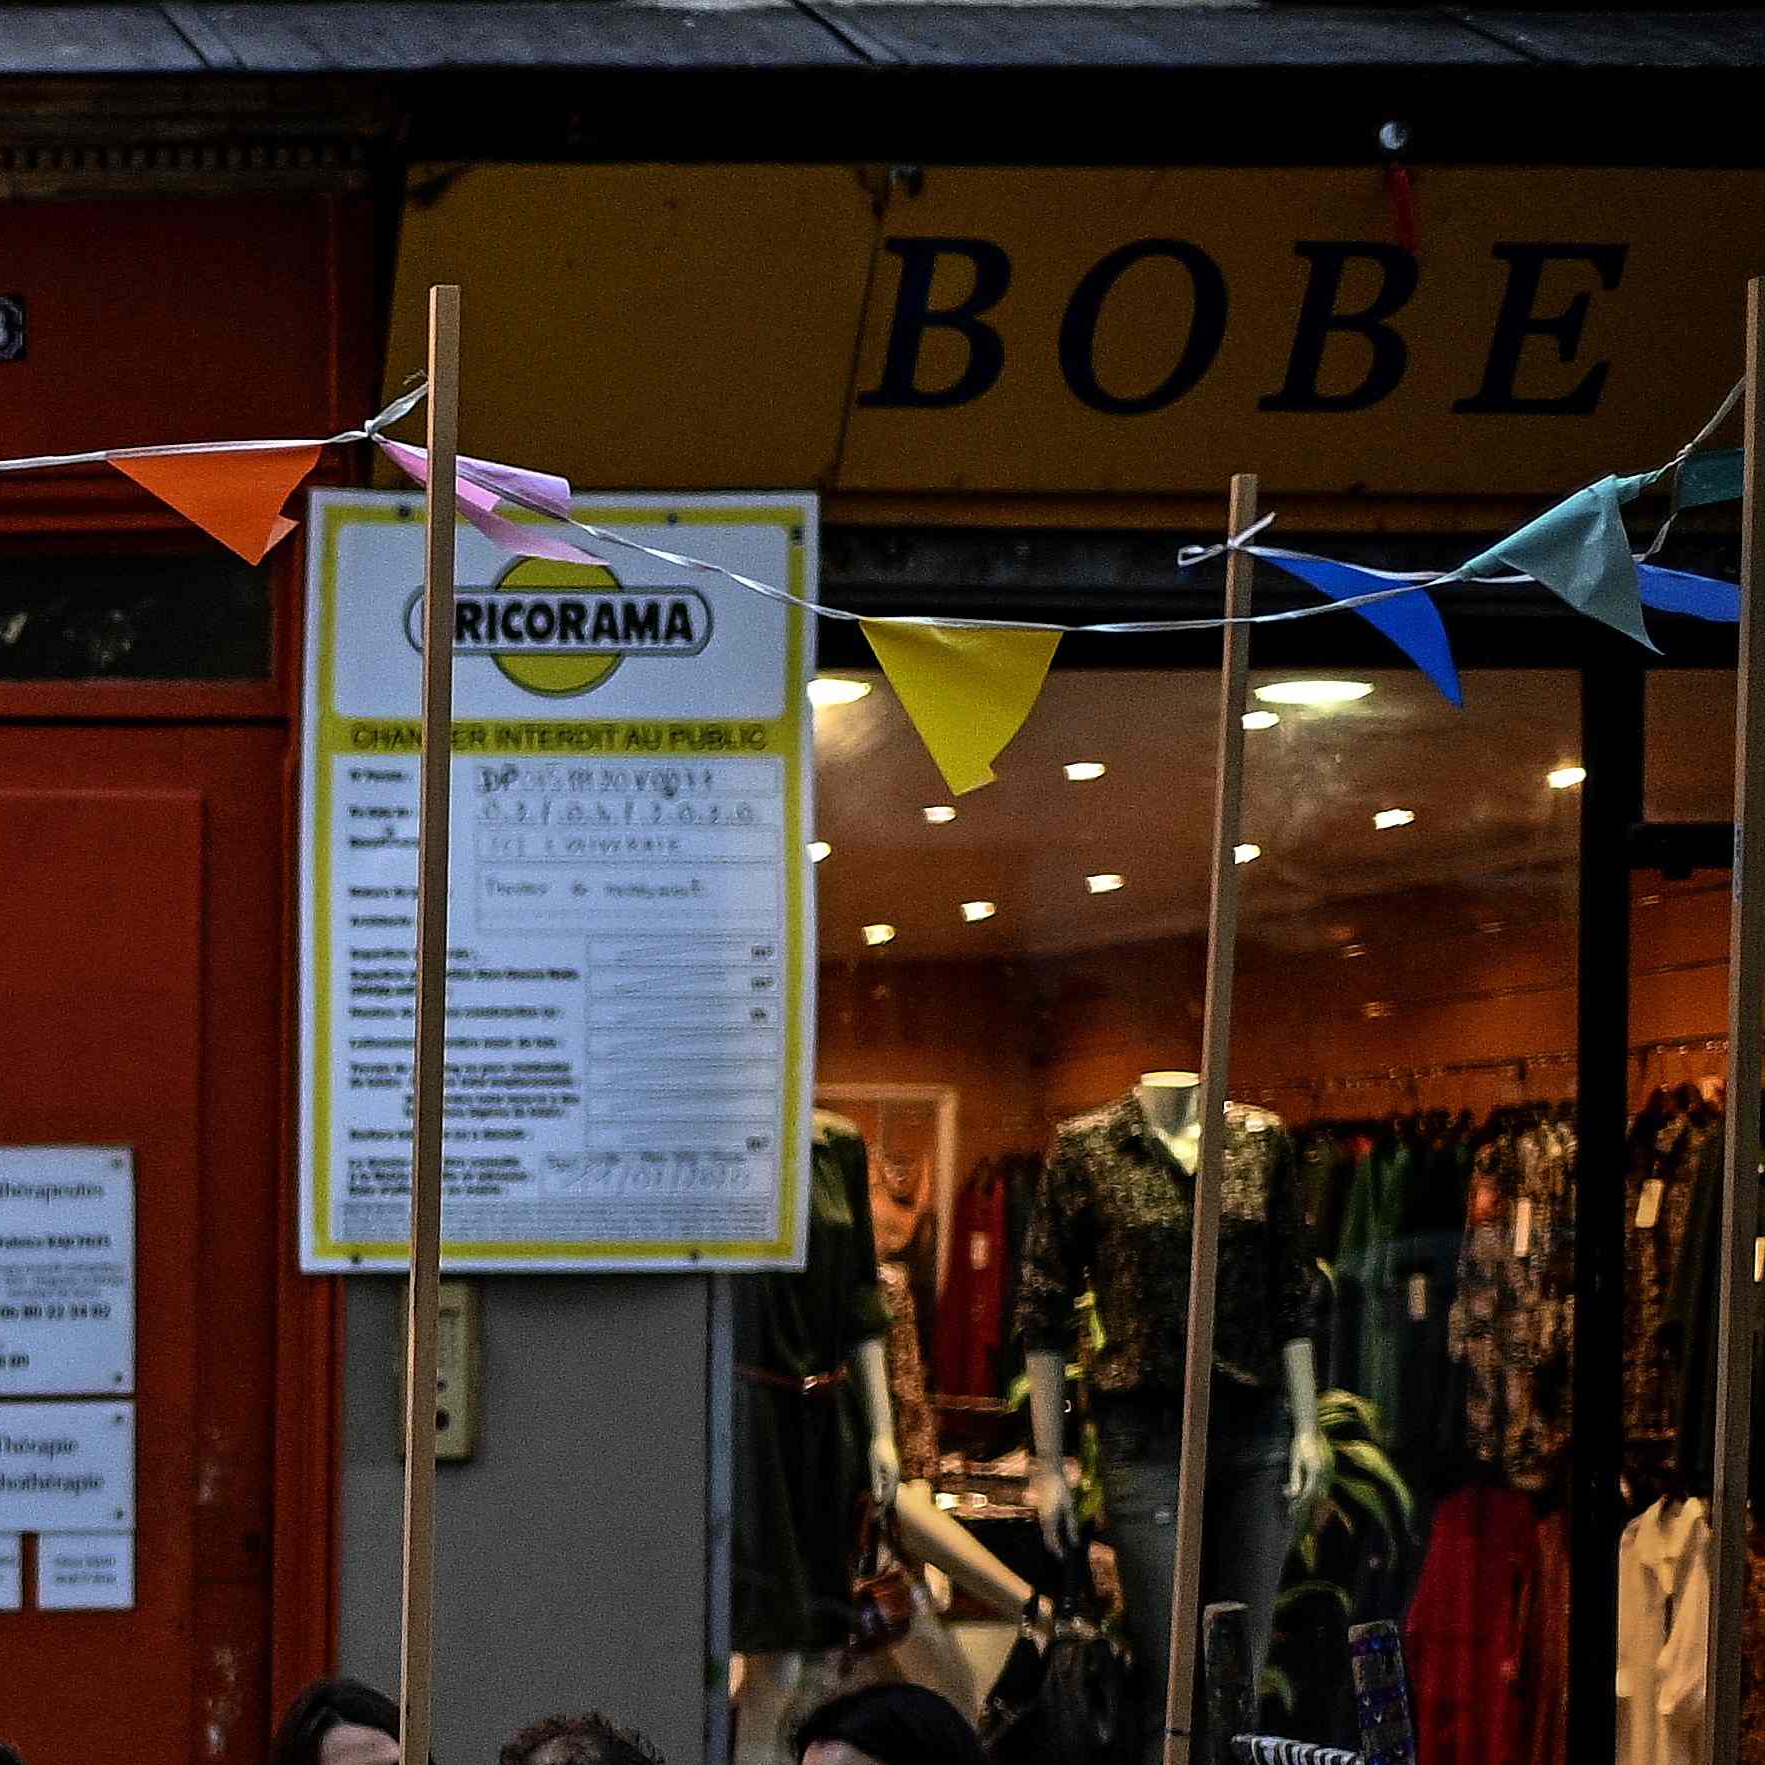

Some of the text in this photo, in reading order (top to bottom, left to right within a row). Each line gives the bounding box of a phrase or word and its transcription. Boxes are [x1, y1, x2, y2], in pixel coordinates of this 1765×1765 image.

[857, 236, 1631, 416] BOBE
[452, 602, 692, 642] RICORAMA
[352, 724, 768, 752] CHANER INTERDIT AU PUBLIC
